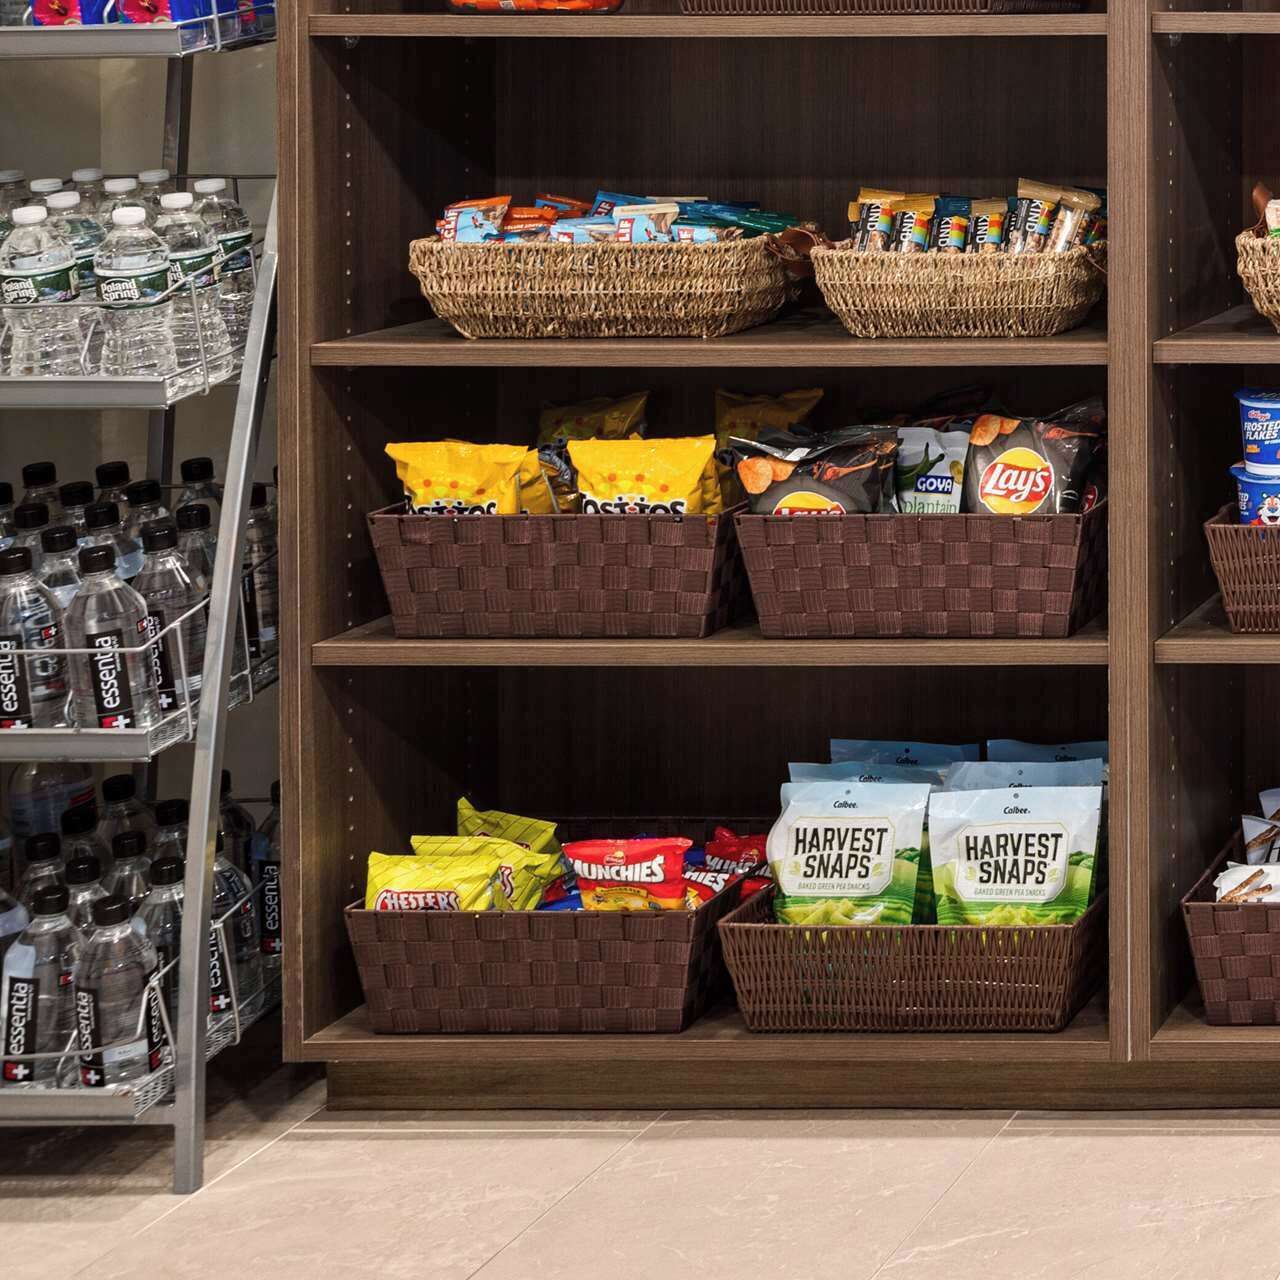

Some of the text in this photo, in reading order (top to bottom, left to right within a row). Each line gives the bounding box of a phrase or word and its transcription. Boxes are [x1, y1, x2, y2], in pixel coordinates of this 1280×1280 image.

[867, 202, 882, 231] KIND
[900, 211, 916, 242] KIND
[976, 214, 990, 244] KIND
[1026, 199, 1043, 232] KIND
[939, 216, 953, 247] KIND
[101, 279, 137, 293] Poland
[102, 287, 140, 304] Spring
[1245, 431, 1279, 441] FLAKES
[917, 476, 953, 492] GOYA
[984, 461, 1052, 501] Lay's
[93, 635, 121, 711] essentia
[859, 774, 883, 783] Calbee
[833, 800, 858, 809] Calbee
[1003, 806, 1030, 815] Calbee
[794, 827, 888, 856] HARVEST
[965, 832, 1063, 862] HARVEST
[569, 855, 665, 884] MUNCHIES
[803, 854, 872, 879] SNAPS
[979, 860, 1049, 885] SNAPS
[818, 882, 870, 891] GREEN SNACKS
[1023, 887, 1046, 897] SNACKS
[9, 982, 28, 1056] essentia
[76, 991, 93, 1062] essentia
